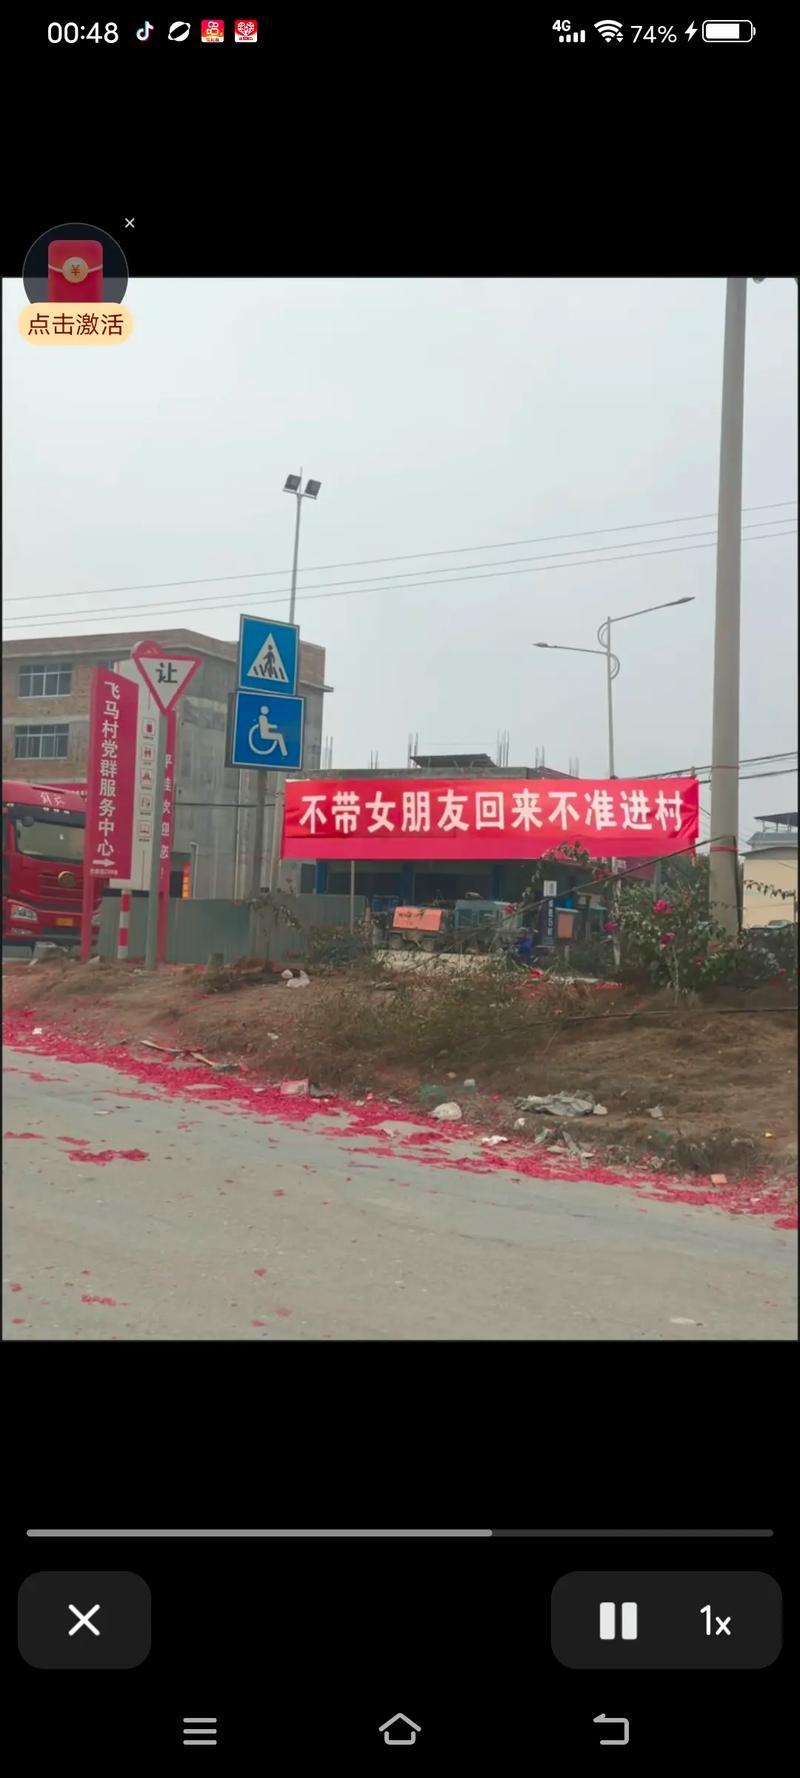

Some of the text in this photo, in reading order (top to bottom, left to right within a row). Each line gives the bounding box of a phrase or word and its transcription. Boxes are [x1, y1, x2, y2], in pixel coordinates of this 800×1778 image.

[155, 662, 178, 684] 让
[97, 681, 121, 857] 飞马村党群服务中心
[299, 788, 684, 834] 不带女朋友回来不准进村
